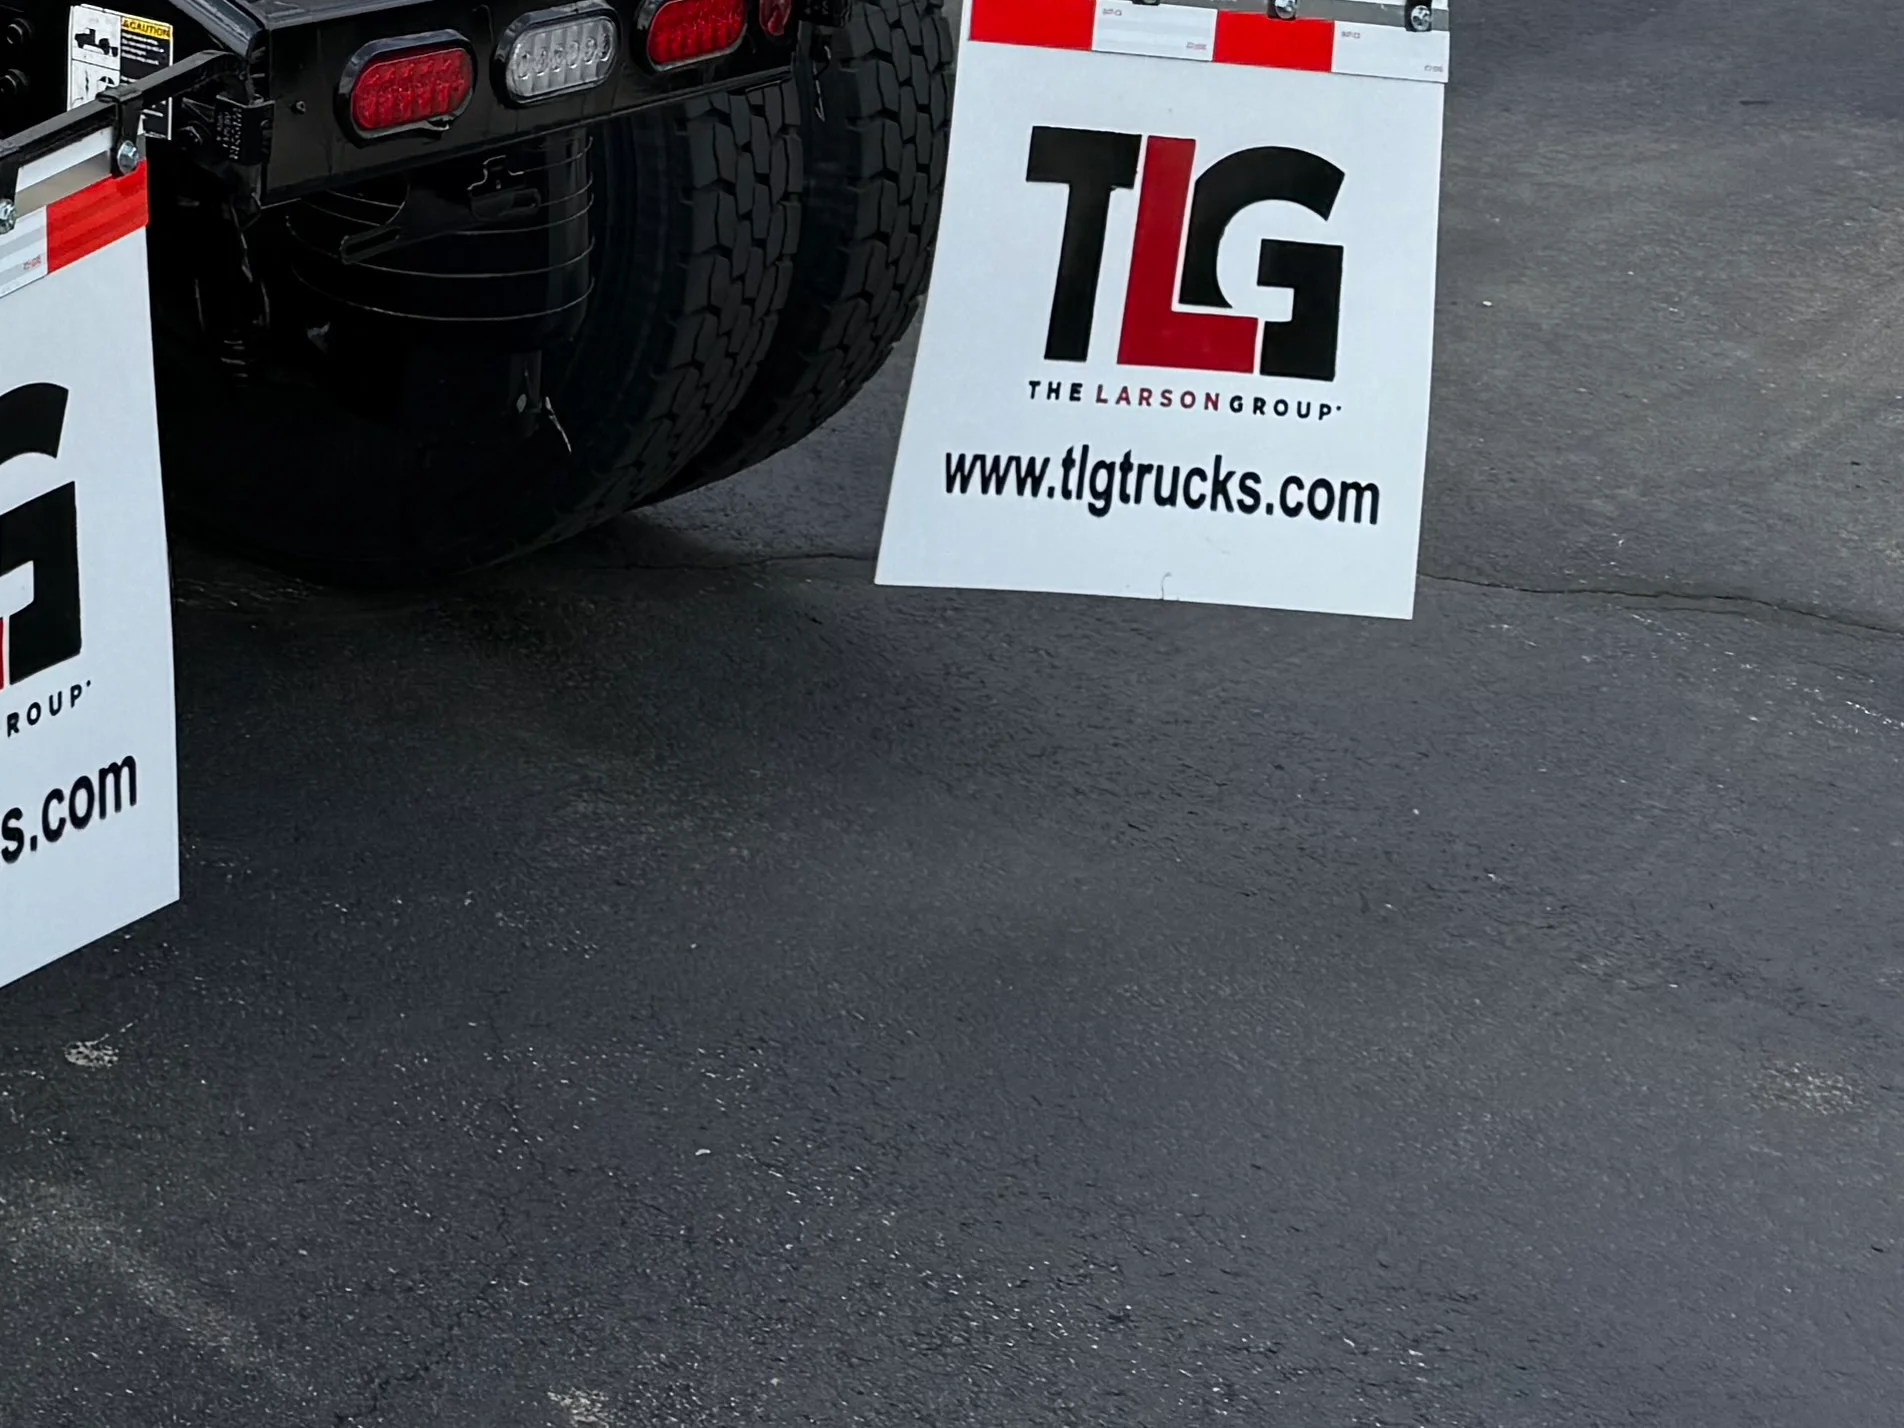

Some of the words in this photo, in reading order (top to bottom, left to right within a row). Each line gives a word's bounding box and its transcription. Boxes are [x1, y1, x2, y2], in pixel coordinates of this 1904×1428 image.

[130, 20, 171, 39] CAUTION
[1026, 125, 1345, 382] TLG
[1028, 379, 1083, 402] THE
[1095, 383, 1221, 412] LARSON
[1229, 394, 1333, 421] GROUP
[944, 443, 1380, 526] www.tlgtrucks.com
